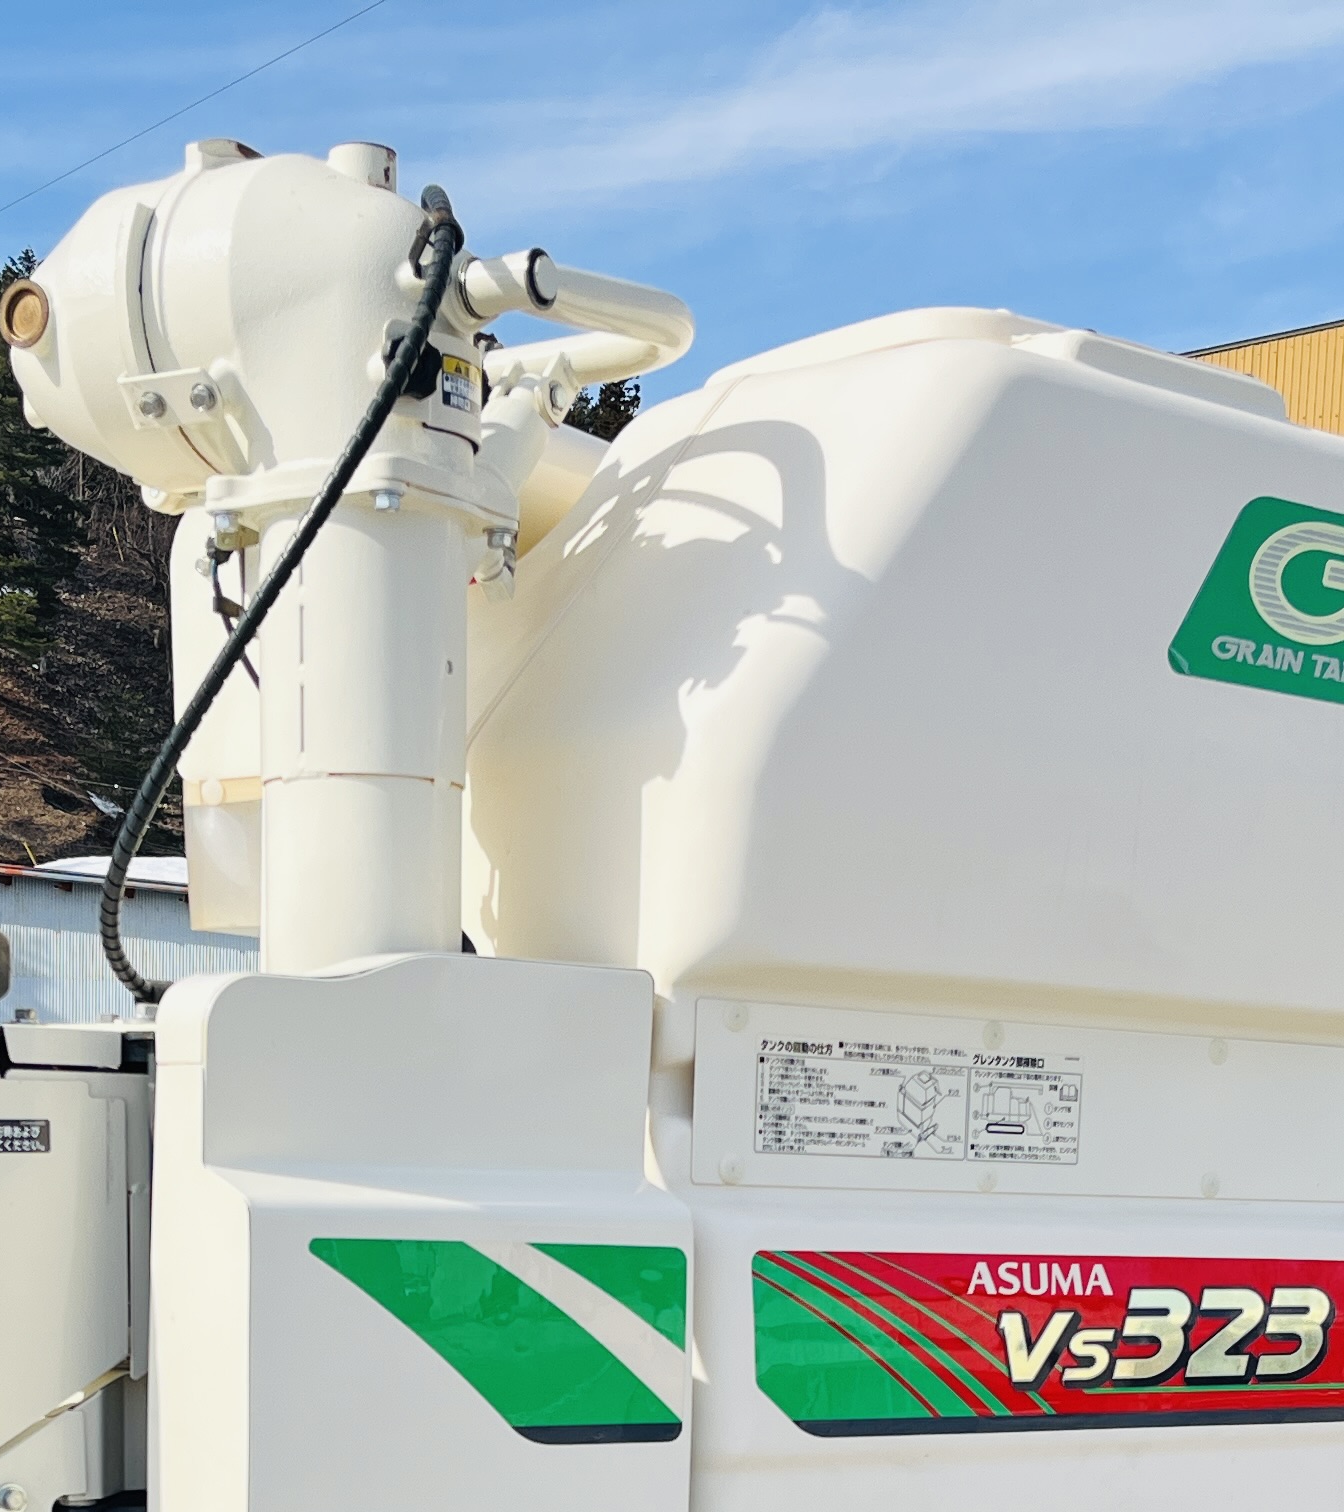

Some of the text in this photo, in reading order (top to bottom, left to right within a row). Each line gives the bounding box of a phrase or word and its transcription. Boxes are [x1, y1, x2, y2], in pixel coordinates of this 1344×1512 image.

[1211, 635, 1304, 674] GRAIN
[967, 1261, 1114, 1297] ASUMA
[996, 1286, 1336, 1391] Vs323
